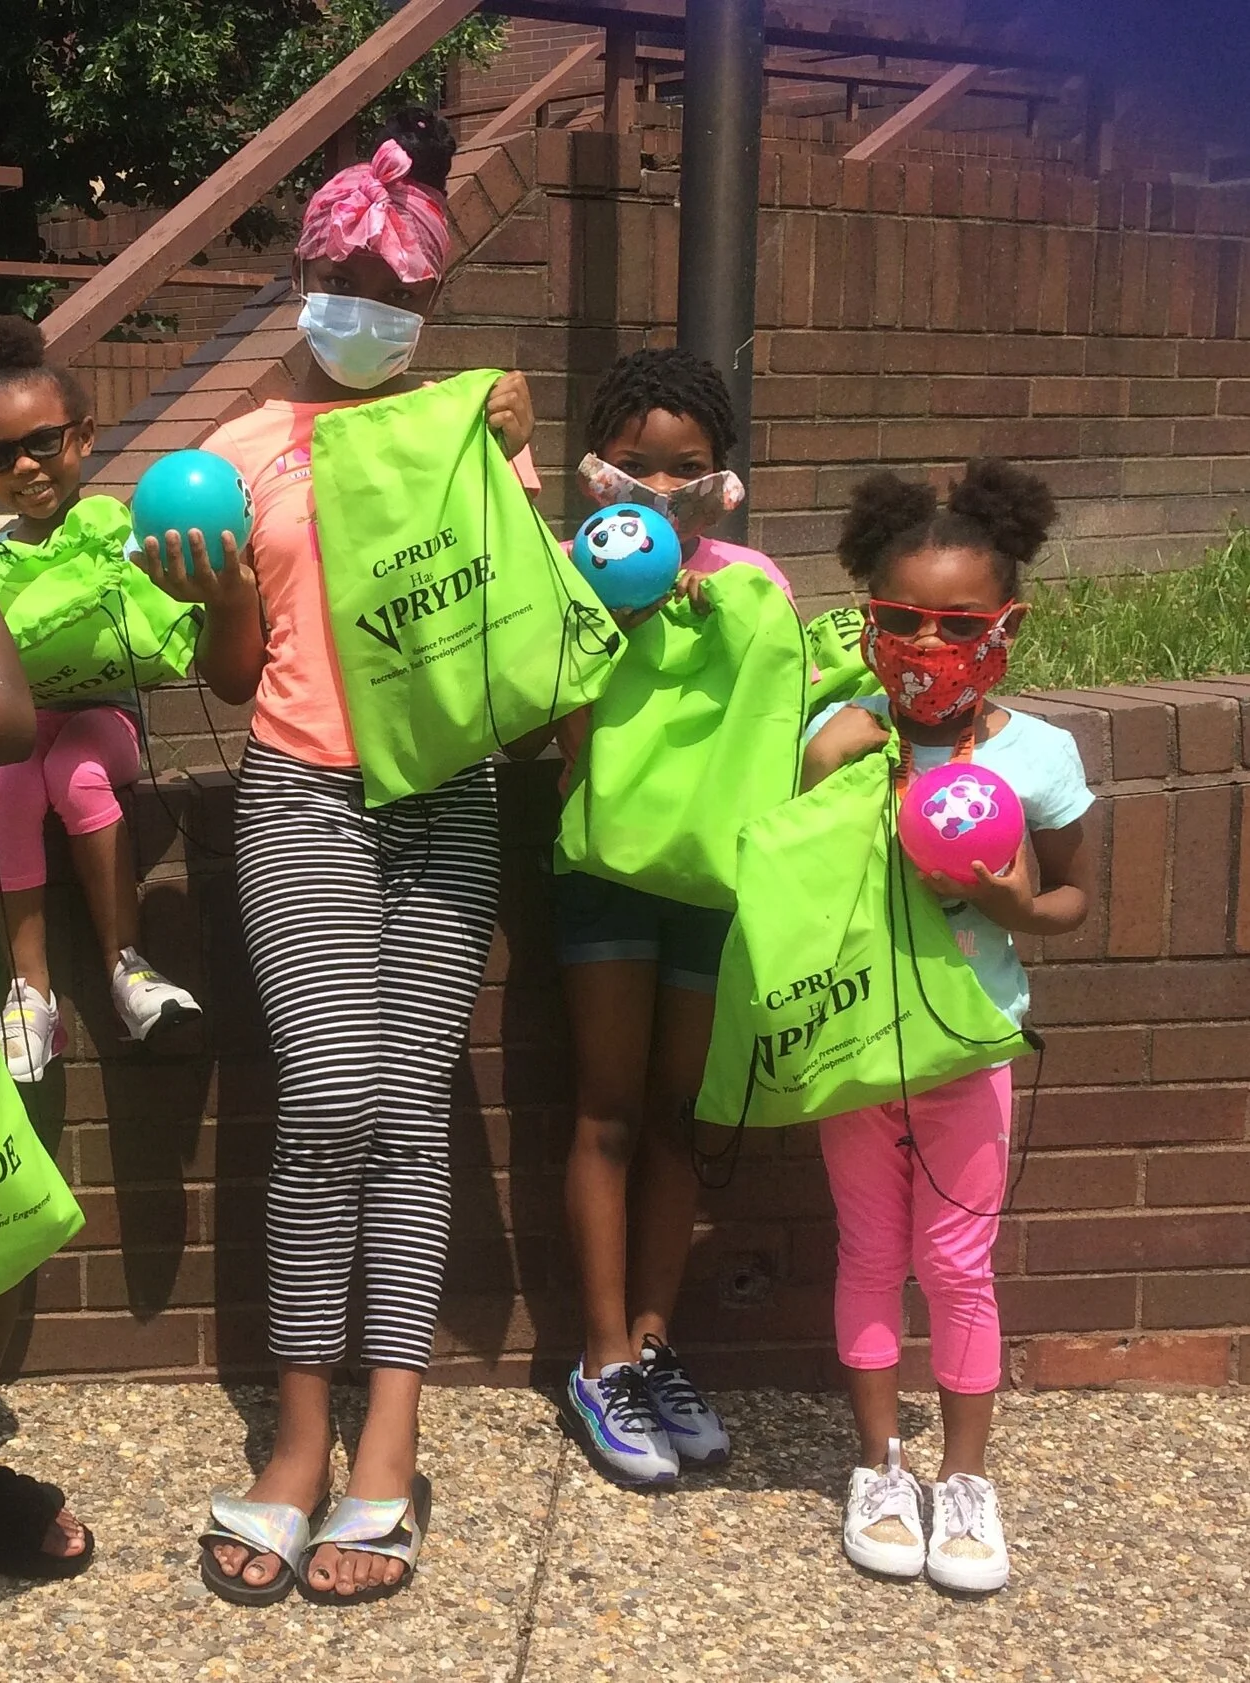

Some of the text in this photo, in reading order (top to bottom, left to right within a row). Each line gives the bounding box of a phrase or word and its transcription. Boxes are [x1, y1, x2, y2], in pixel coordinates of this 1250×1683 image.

[372, 527, 458, 578] C-PRIDE
[410, 571, 434, 588] Has
[355, 554, 496, 655] VPRYDE
[424, 636, 473, 665] Development
[818, 1036, 861, 1061] Prevention,
